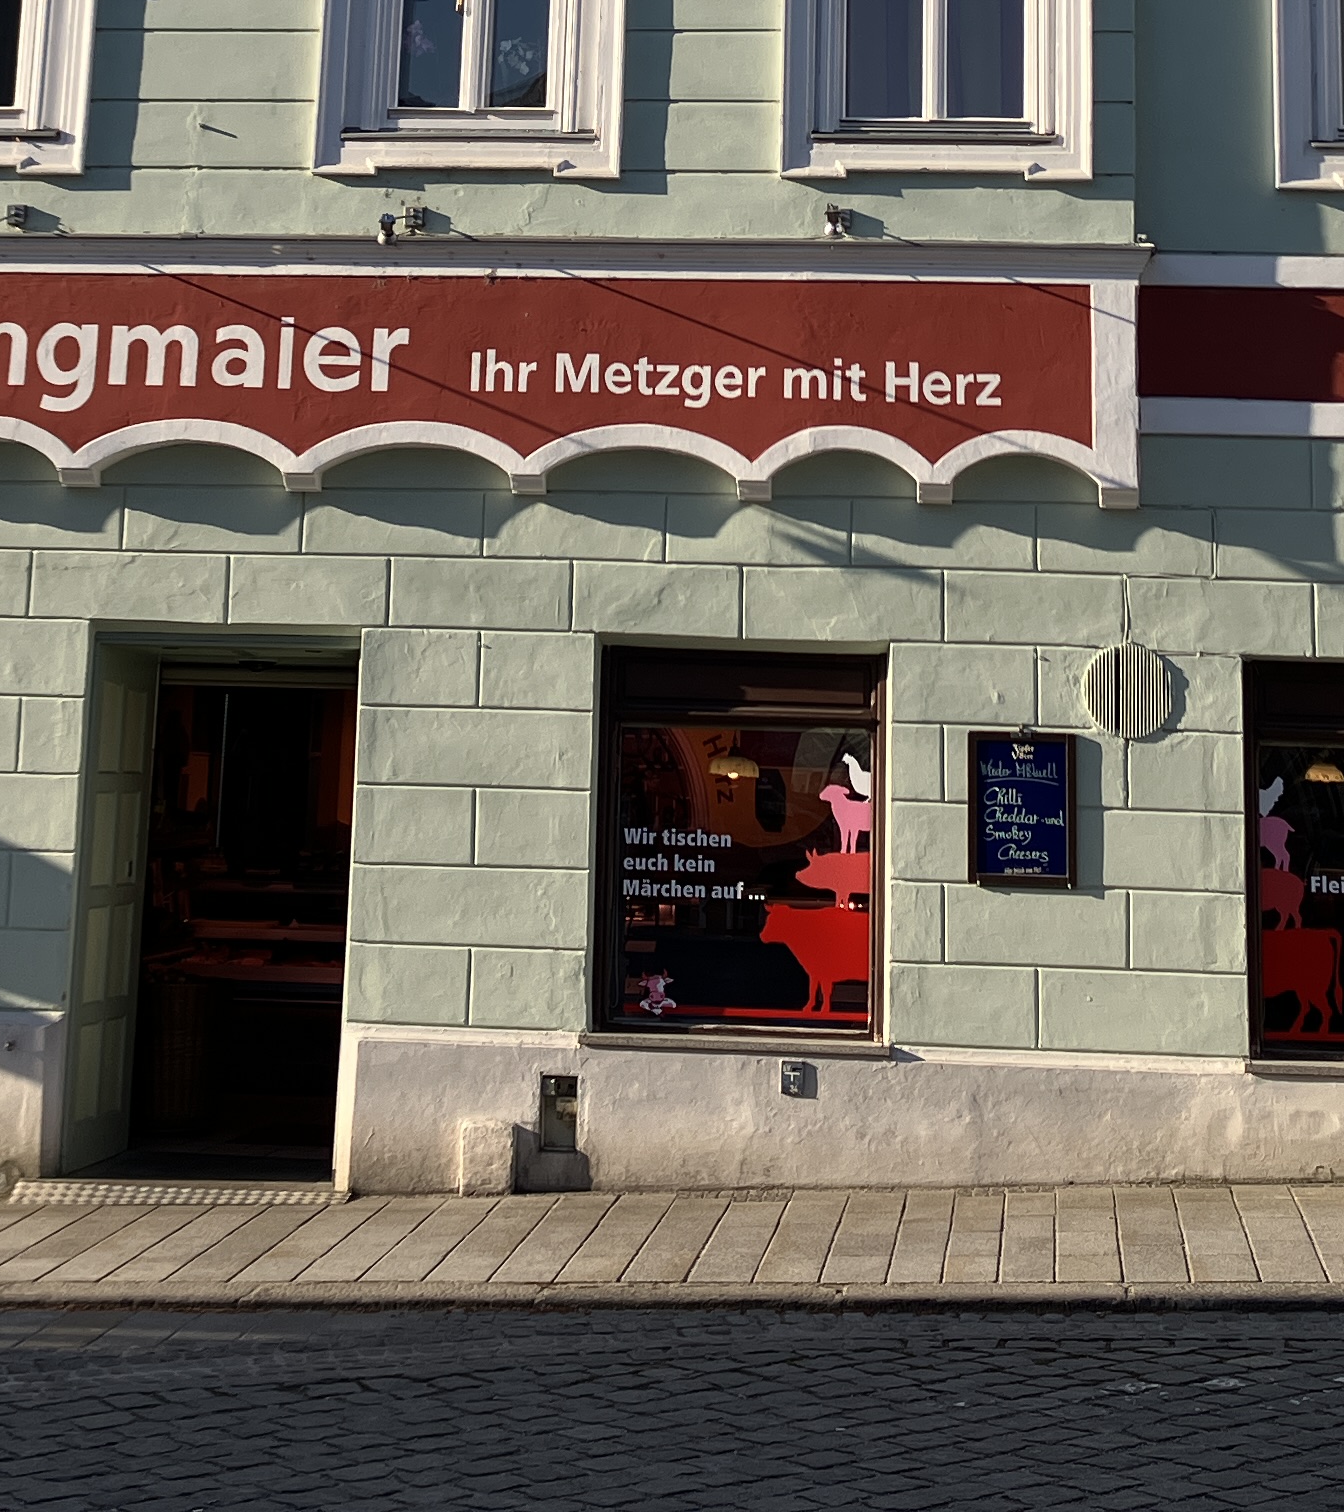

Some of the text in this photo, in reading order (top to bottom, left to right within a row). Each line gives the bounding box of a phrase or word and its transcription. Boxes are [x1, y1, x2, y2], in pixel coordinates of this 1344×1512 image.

[469, 349, 1003, 408] Ihr Metzger mit Herz
[623, 827, 732, 848] Wir tischen
[623, 853, 716, 873] euch kein
[622, 879, 706, 899] Märchen
[711, 881, 745, 900] auf
